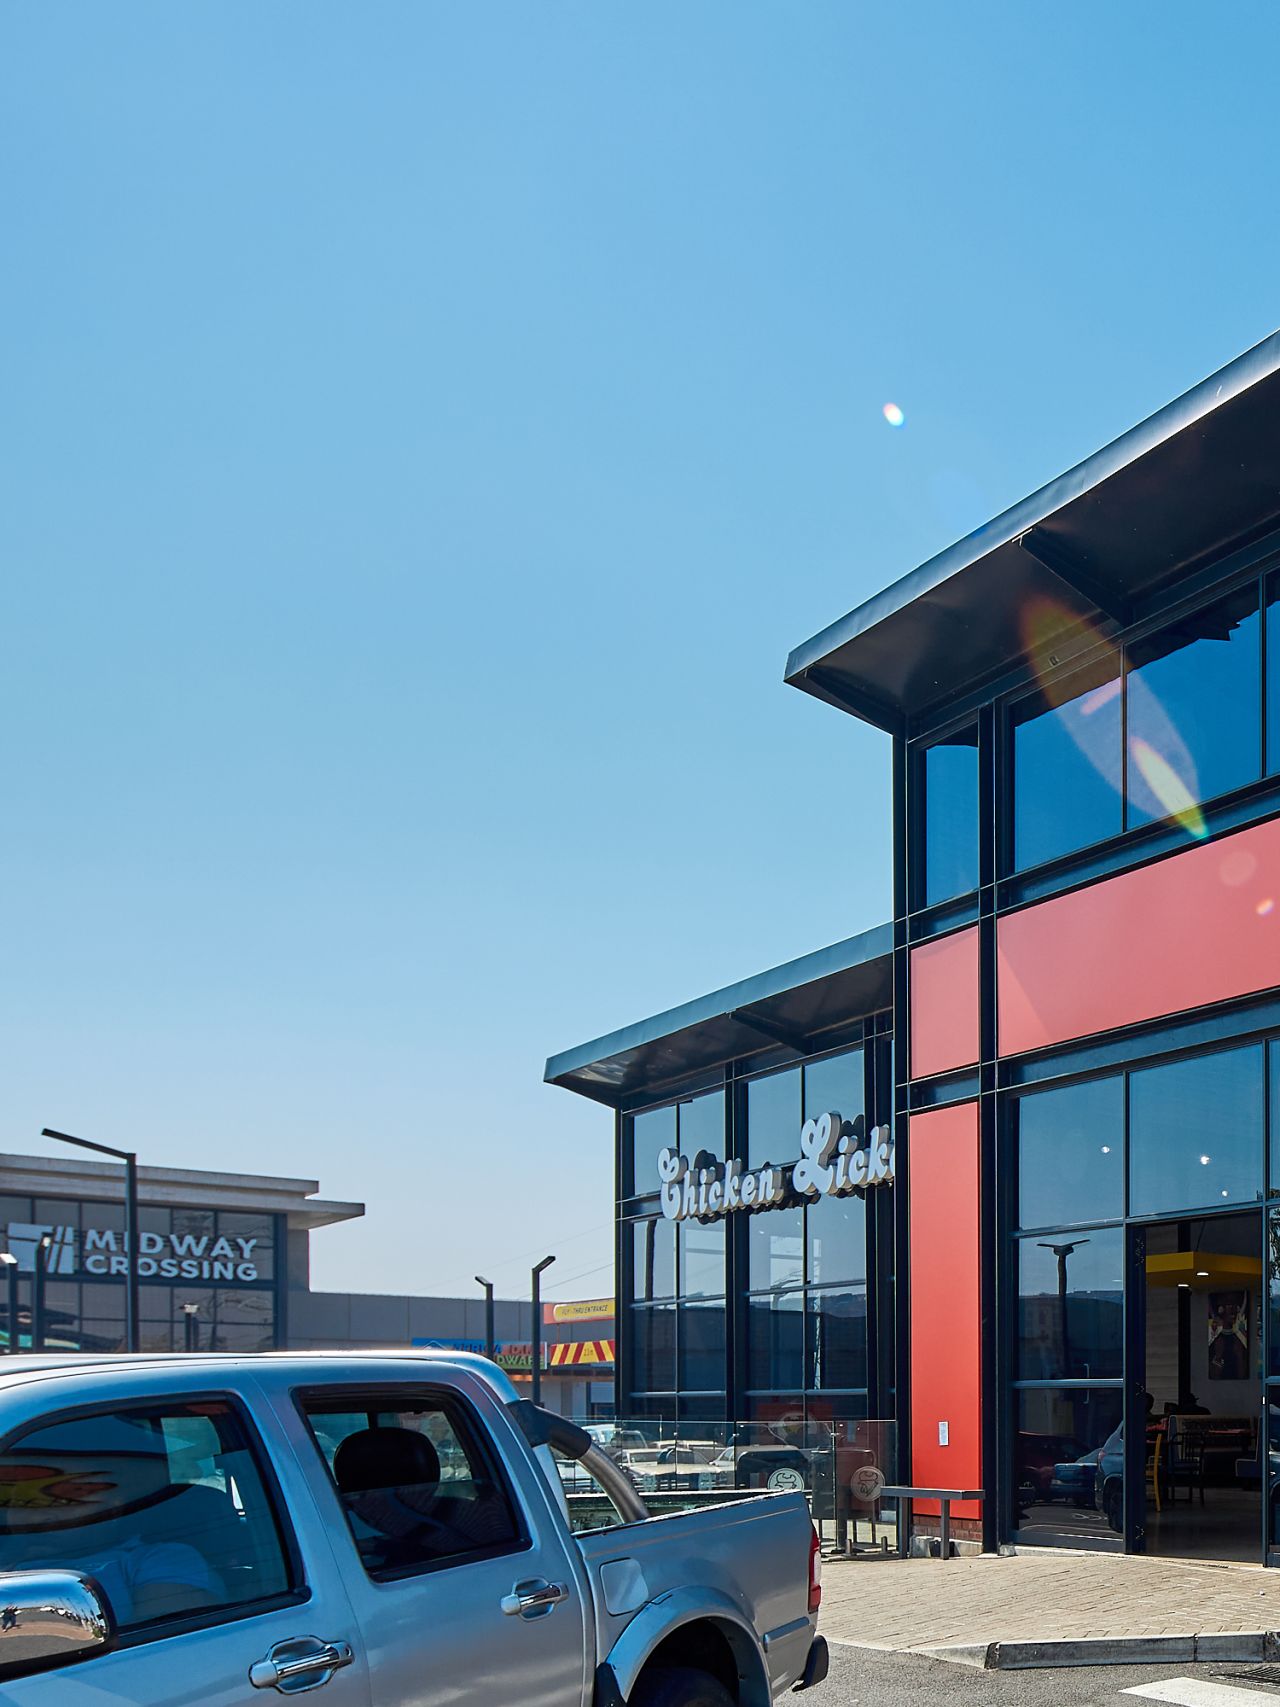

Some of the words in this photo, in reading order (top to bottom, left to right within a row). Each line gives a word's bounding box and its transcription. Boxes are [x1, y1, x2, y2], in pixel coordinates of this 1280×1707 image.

[657, 1147, 783, 1221] Chicken
[793, 1110, 895, 1196] Lick
[85, 1255, 258, 1281] CROSSING
[584, 1304, 608, 1313] ENTRANCE
